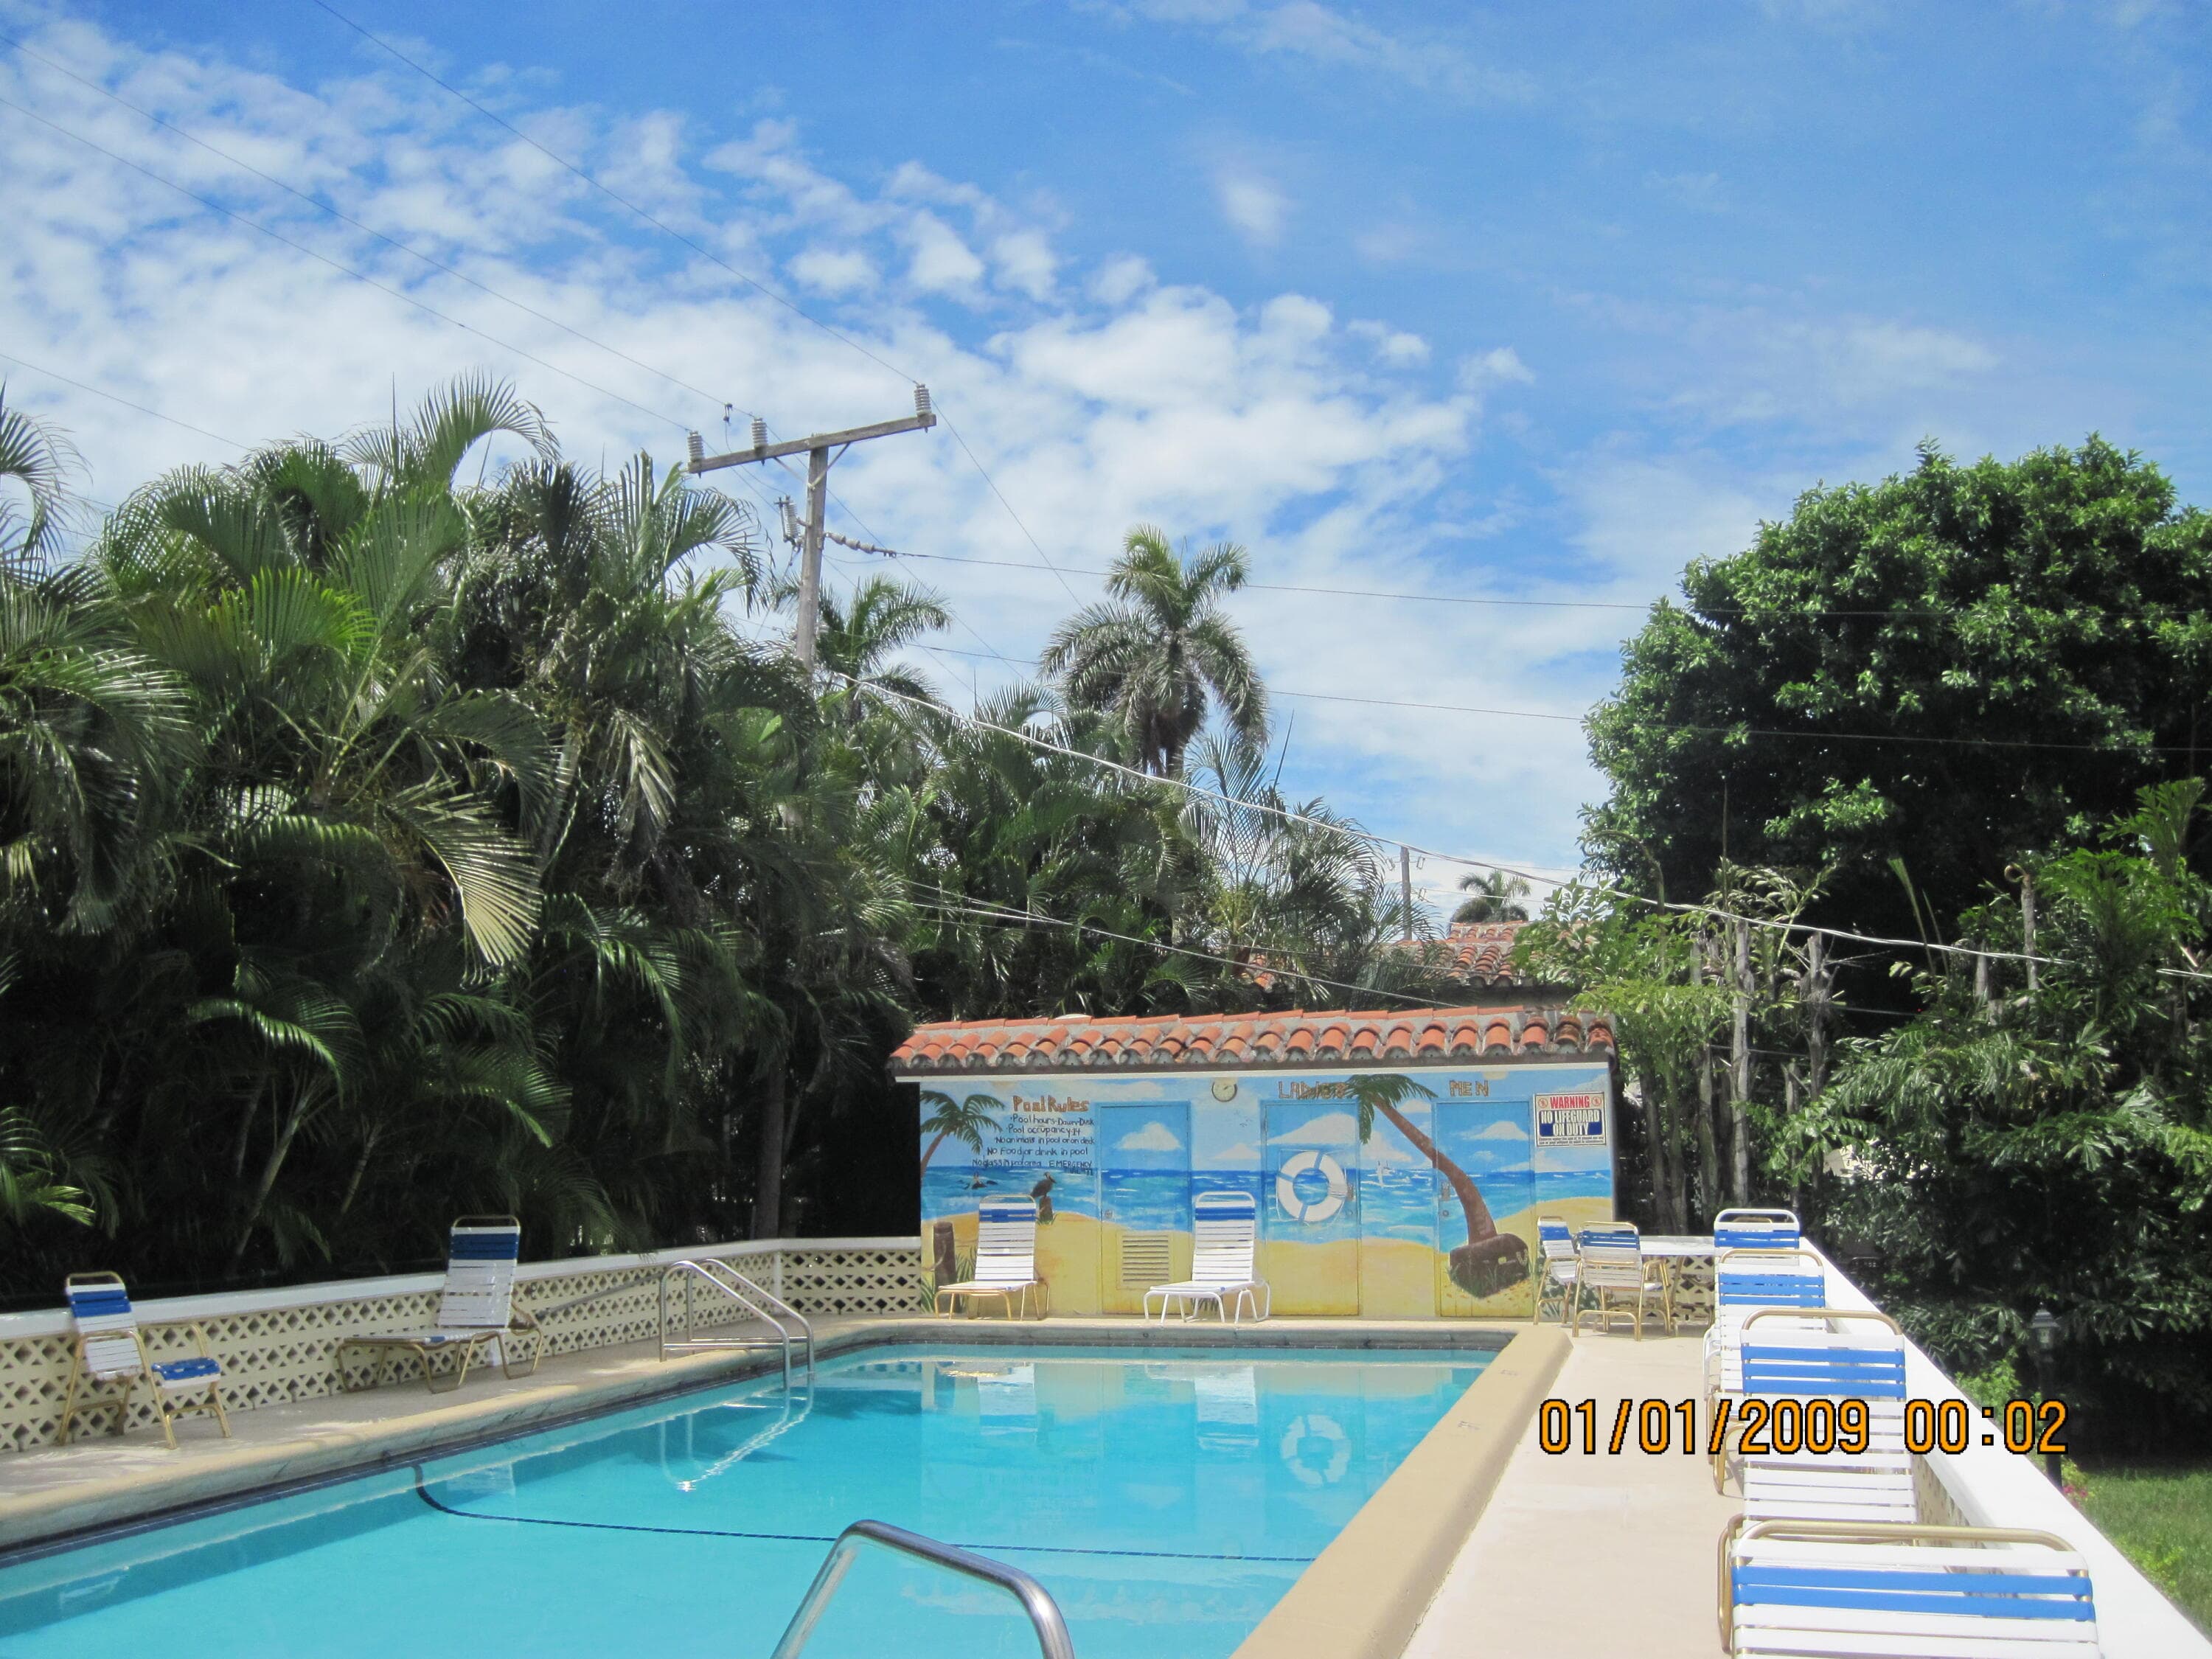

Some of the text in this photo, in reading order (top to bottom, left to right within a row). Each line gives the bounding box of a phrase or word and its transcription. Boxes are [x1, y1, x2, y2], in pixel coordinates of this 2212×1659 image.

[1449, 1079, 1489, 1097] MEN
[1013, 1095, 1089, 1112] Pool Rules
[1550, 1096, 1590, 1109] WARNING
[1540, 1109, 1599, 1124] NO LIFEGUARD
[1008, 1124, 1024, 1133] Pool
[1553, 1121, 1589, 1135] ON DUTY
[1034, 1147, 1057, 1155] drink
[1070, 1147, 1088, 1157] pool
[1048, 1160, 1092, 1168] EMERGENCY
